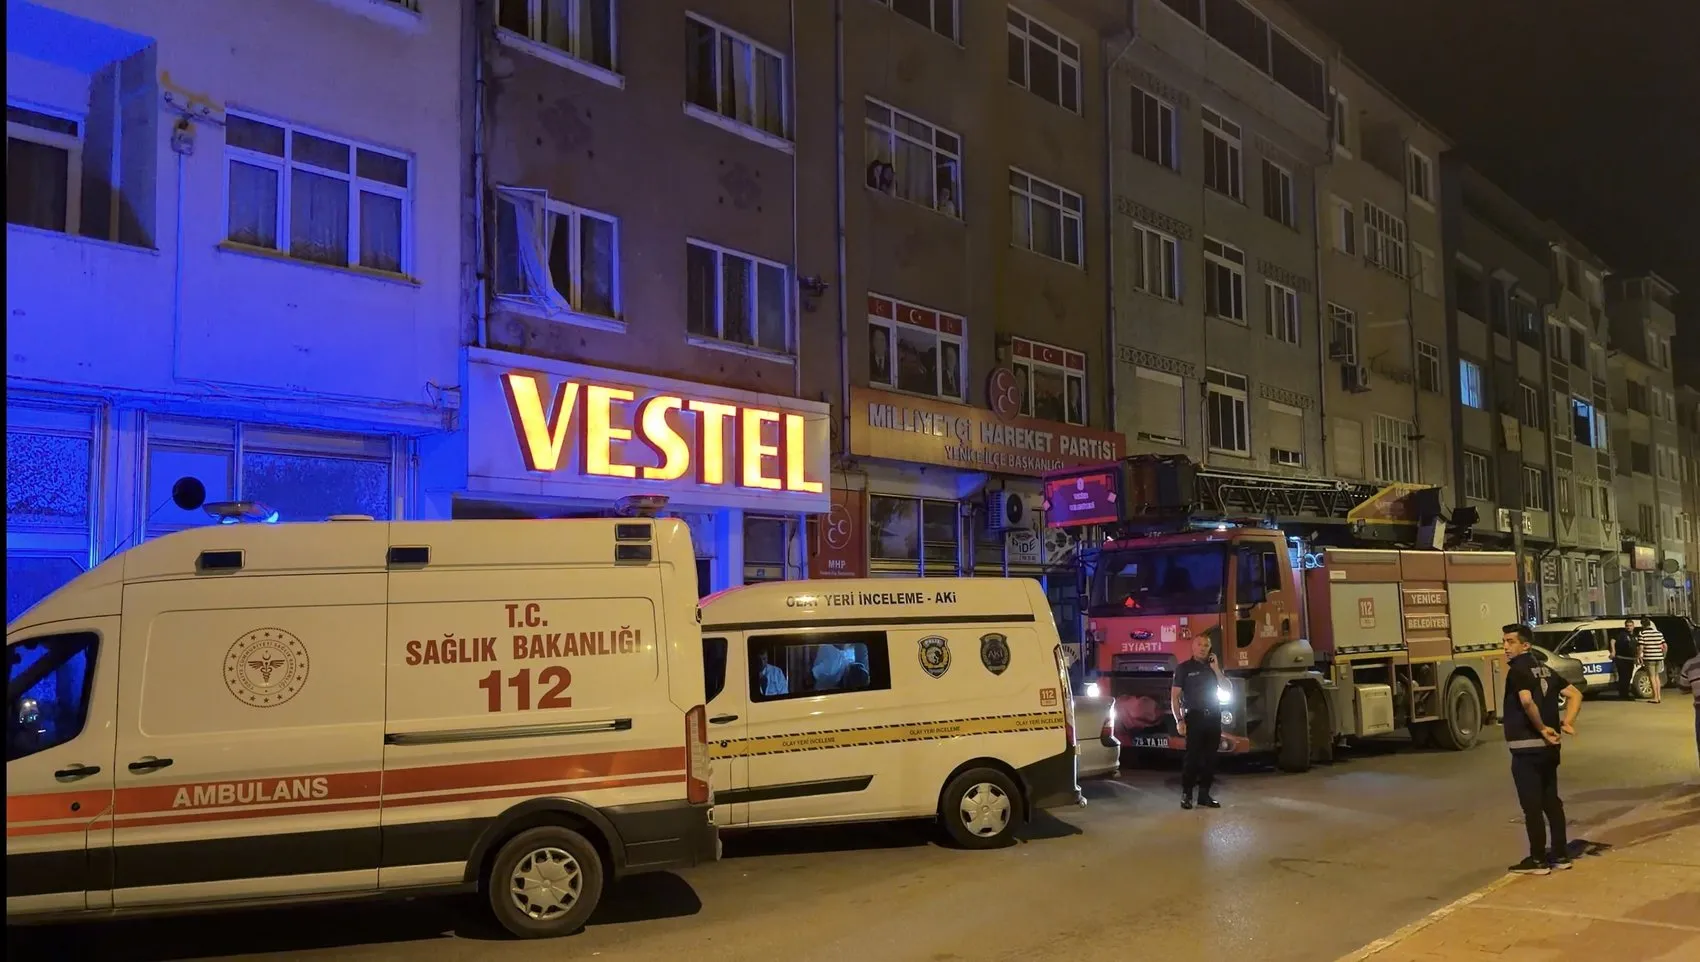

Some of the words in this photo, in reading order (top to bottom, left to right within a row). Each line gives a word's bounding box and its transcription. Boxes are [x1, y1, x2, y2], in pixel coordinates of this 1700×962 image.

[500, 373, 823, 494] VESTEL
[980, 421, 1054, 453] HAREKET
[828, 559, 846, 569] MHP
[824, 591, 855, 606] YERİ
[858, 591, 924, 606] İNCELEME
[1411, 591, 1441, 604] YENİCE
[505, 603, 548, 628] T.C.
[1360, 601, 1373, 615] 112
[406, 633, 497, 666] SAĞLIK
[513, 625, 641, 660] BAKANLIĞI
[479, 665, 572, 713] 112
[1042, 690, 1055, 699] 112
[1146, 738, 1156, 746] YA
[172, 777, 328, 808] AMBULANS
